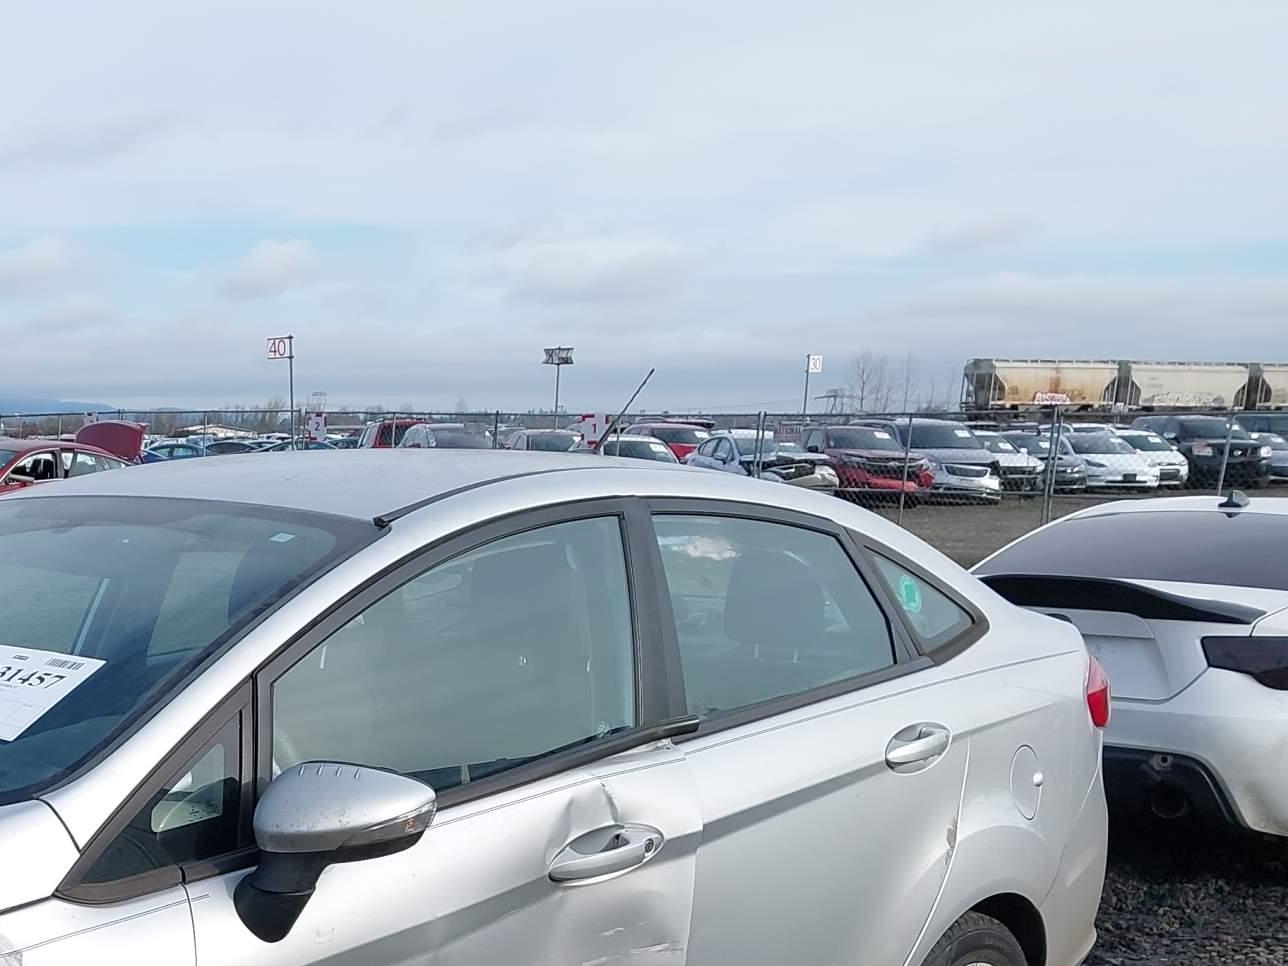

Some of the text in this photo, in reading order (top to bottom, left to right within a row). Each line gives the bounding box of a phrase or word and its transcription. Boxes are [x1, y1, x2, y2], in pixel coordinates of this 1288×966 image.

[269, 339, 286, 356] 40
[811, 357, 821, 370] 30
[314, 421, 321, 431] 2
[591, 423, 597, 434] 1
